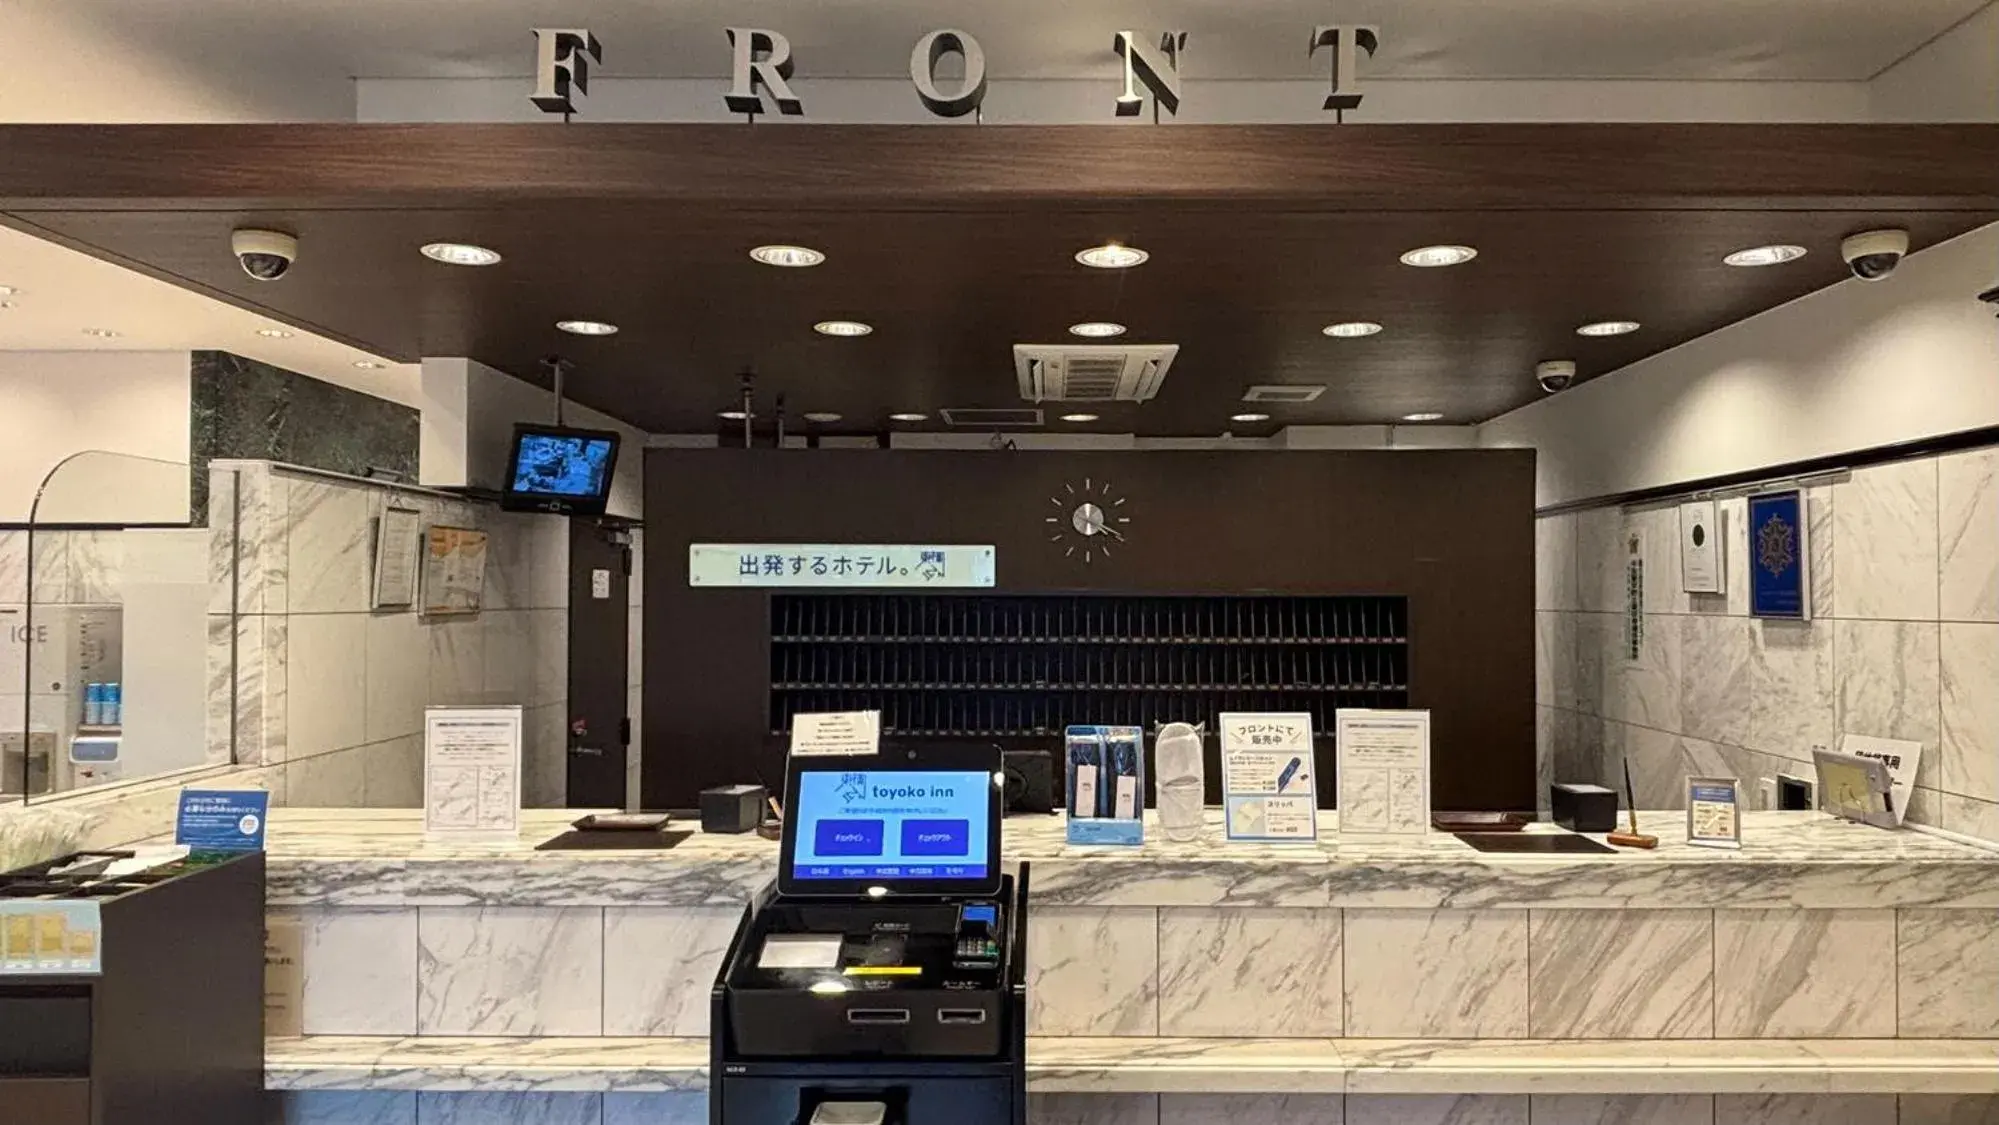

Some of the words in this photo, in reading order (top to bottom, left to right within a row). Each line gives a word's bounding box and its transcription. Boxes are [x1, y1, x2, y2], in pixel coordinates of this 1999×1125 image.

[529, 25, 1380, 117] FRONT
[739, 554, 909, 576] 出発するホテル。
[11, 625, 48, 643] ICE
[1238, 724, 1294, 735] フロントにて
[1251, 734, 1283, 744] 販売中
[872, 785, 926, 800] toyoko
[930, 785, 954, 798] inn
